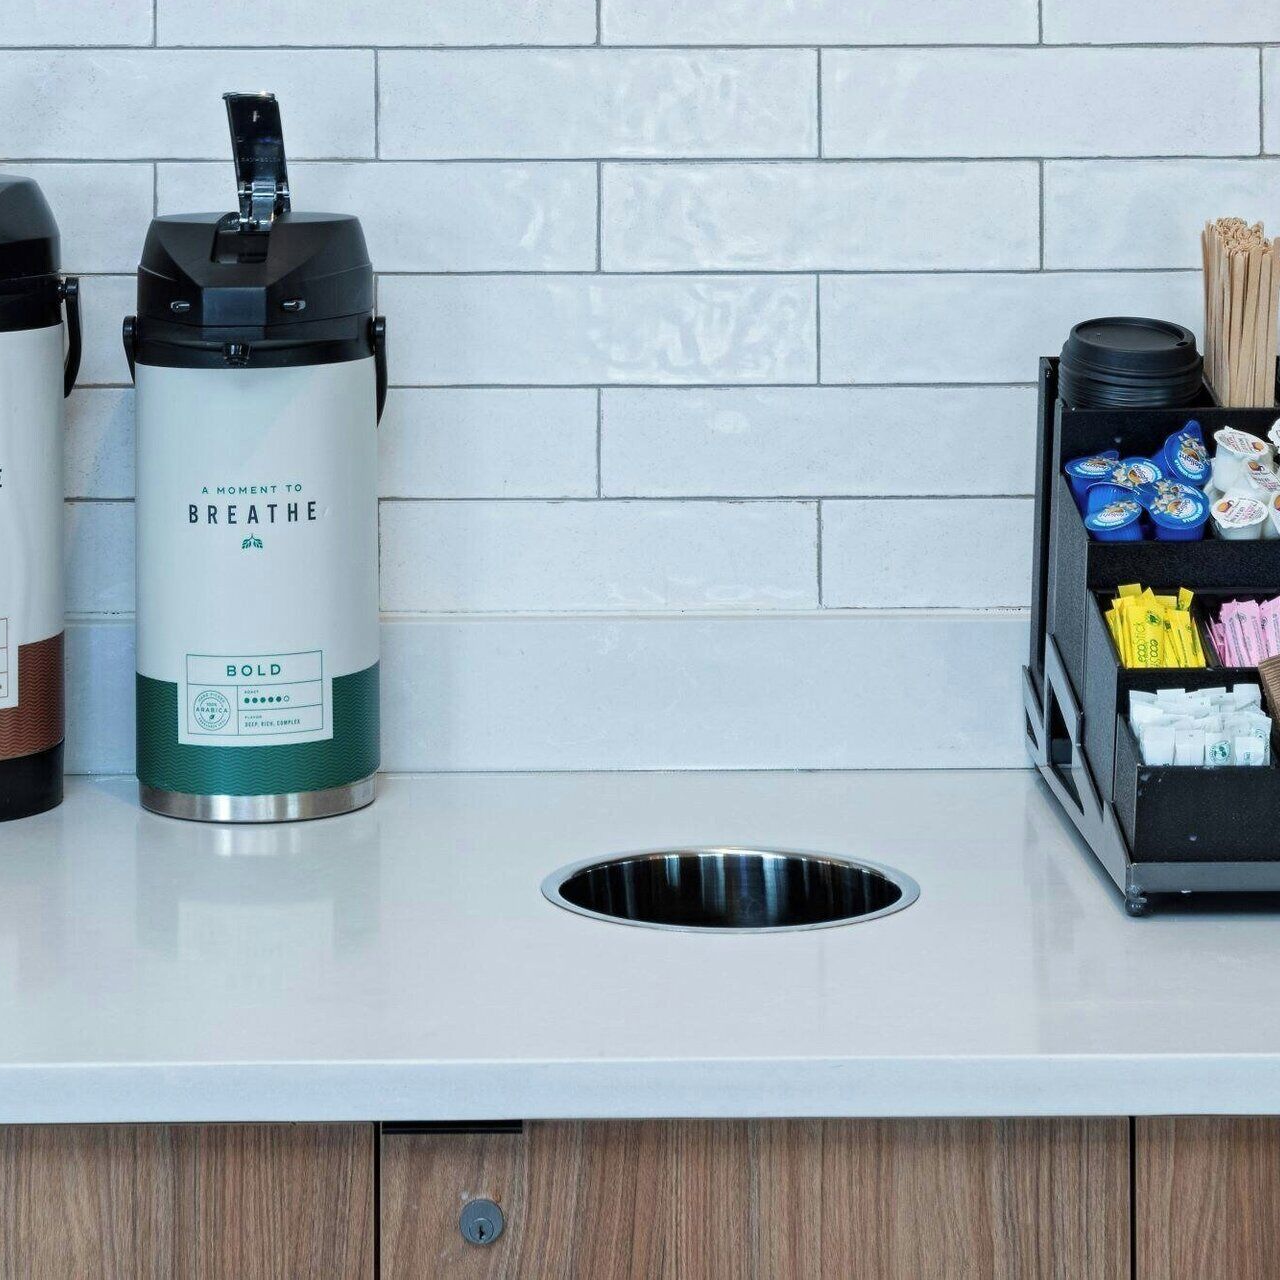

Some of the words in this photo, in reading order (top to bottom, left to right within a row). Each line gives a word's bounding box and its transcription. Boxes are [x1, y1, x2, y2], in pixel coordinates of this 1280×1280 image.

[201, 486, 209, 494] A
[216, 485, 277, 494] MOMENT
[285, 483, 302, 492] TO
[189, 501, 317, 524] BREATHE
[226, 664, 281, 677] BOLD
